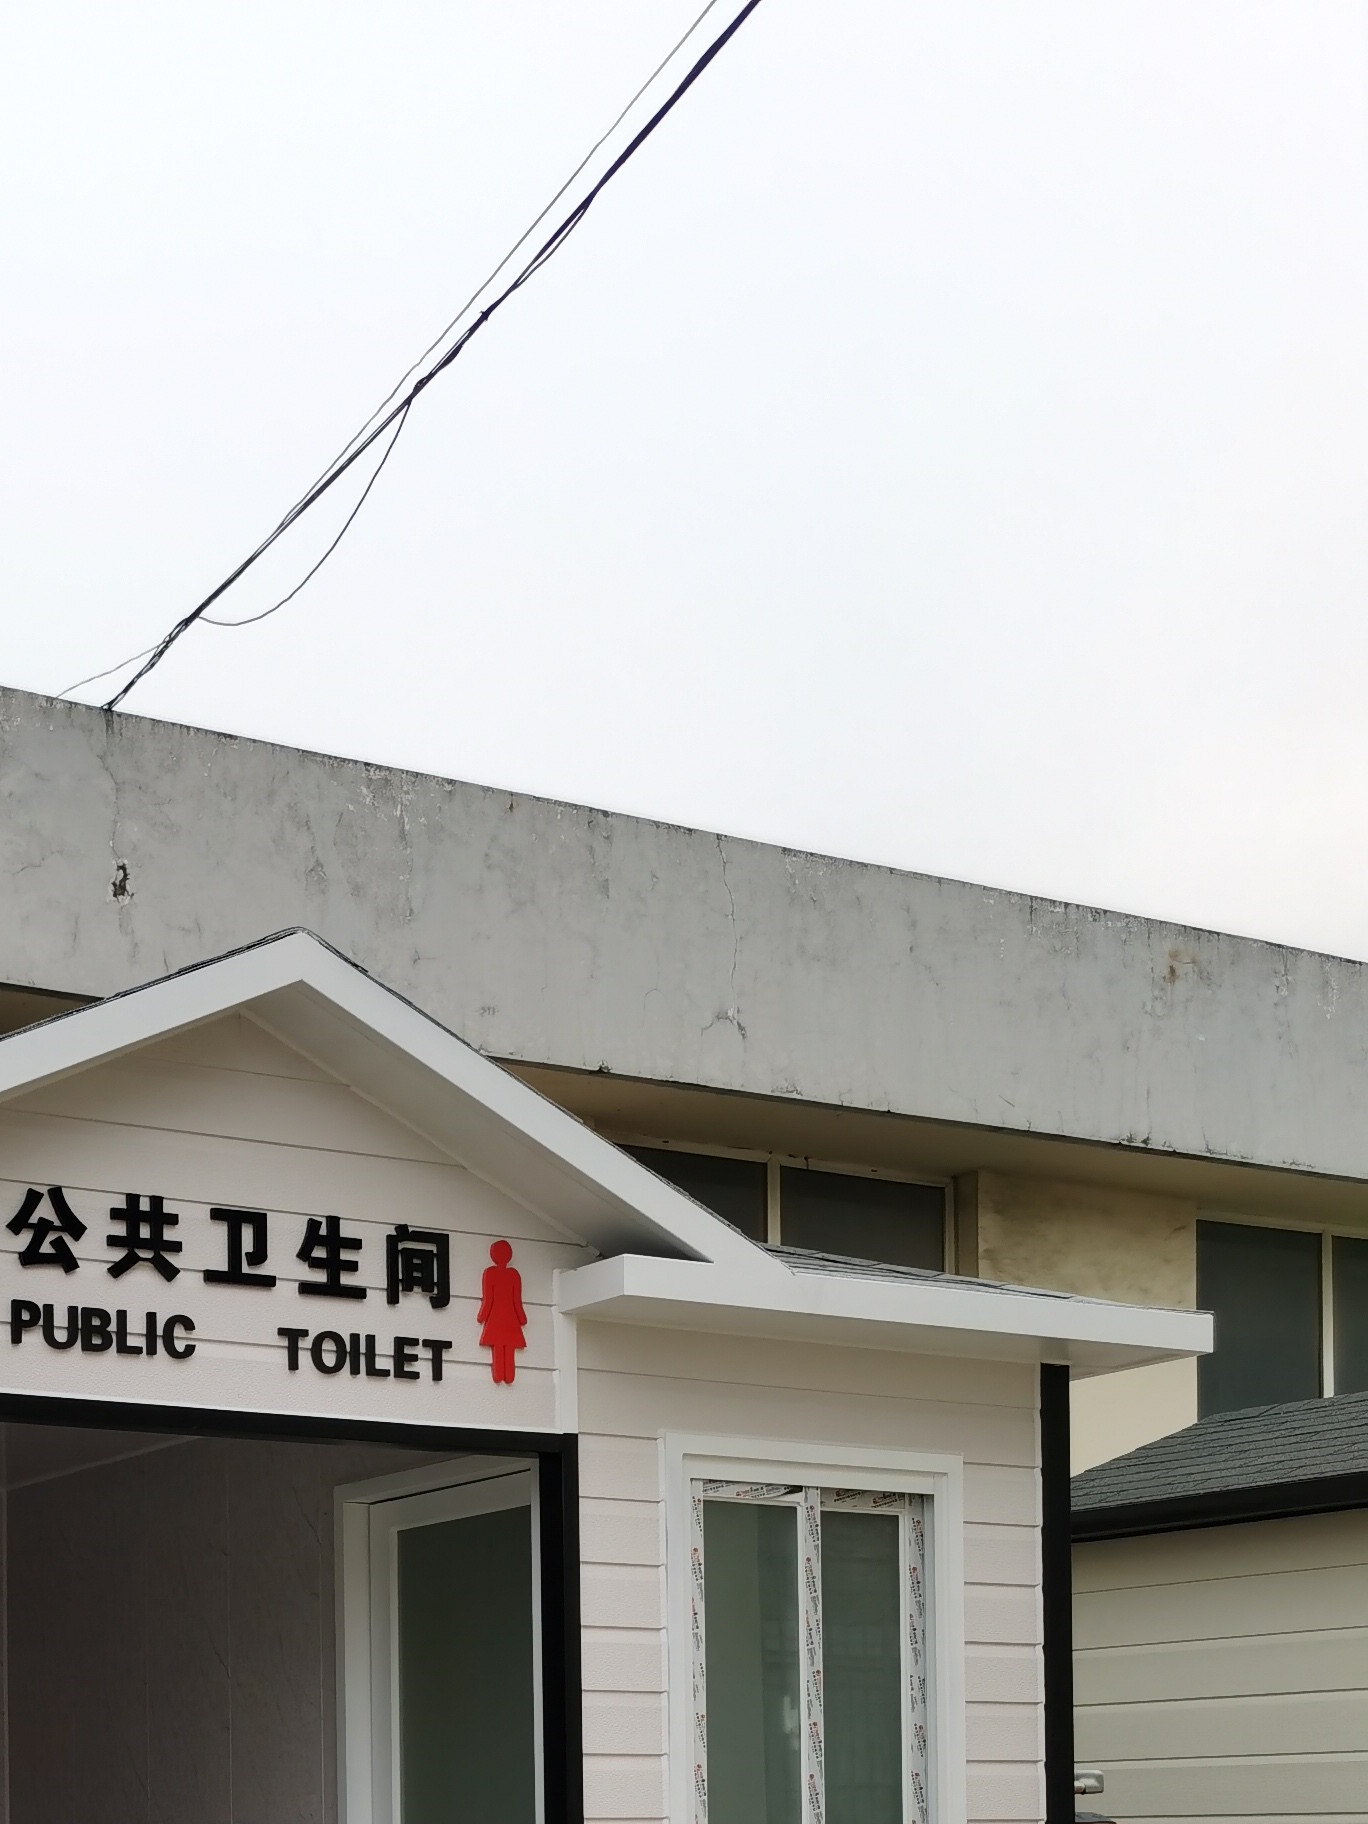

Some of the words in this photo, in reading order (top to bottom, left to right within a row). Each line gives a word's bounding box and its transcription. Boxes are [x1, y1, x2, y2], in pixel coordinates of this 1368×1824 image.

[6, 1185, 451, 1309] 公共卫生间
[10, 1298, 197, 1359] PUBLIC
[277, 1326, 453, 1381] TOILET
